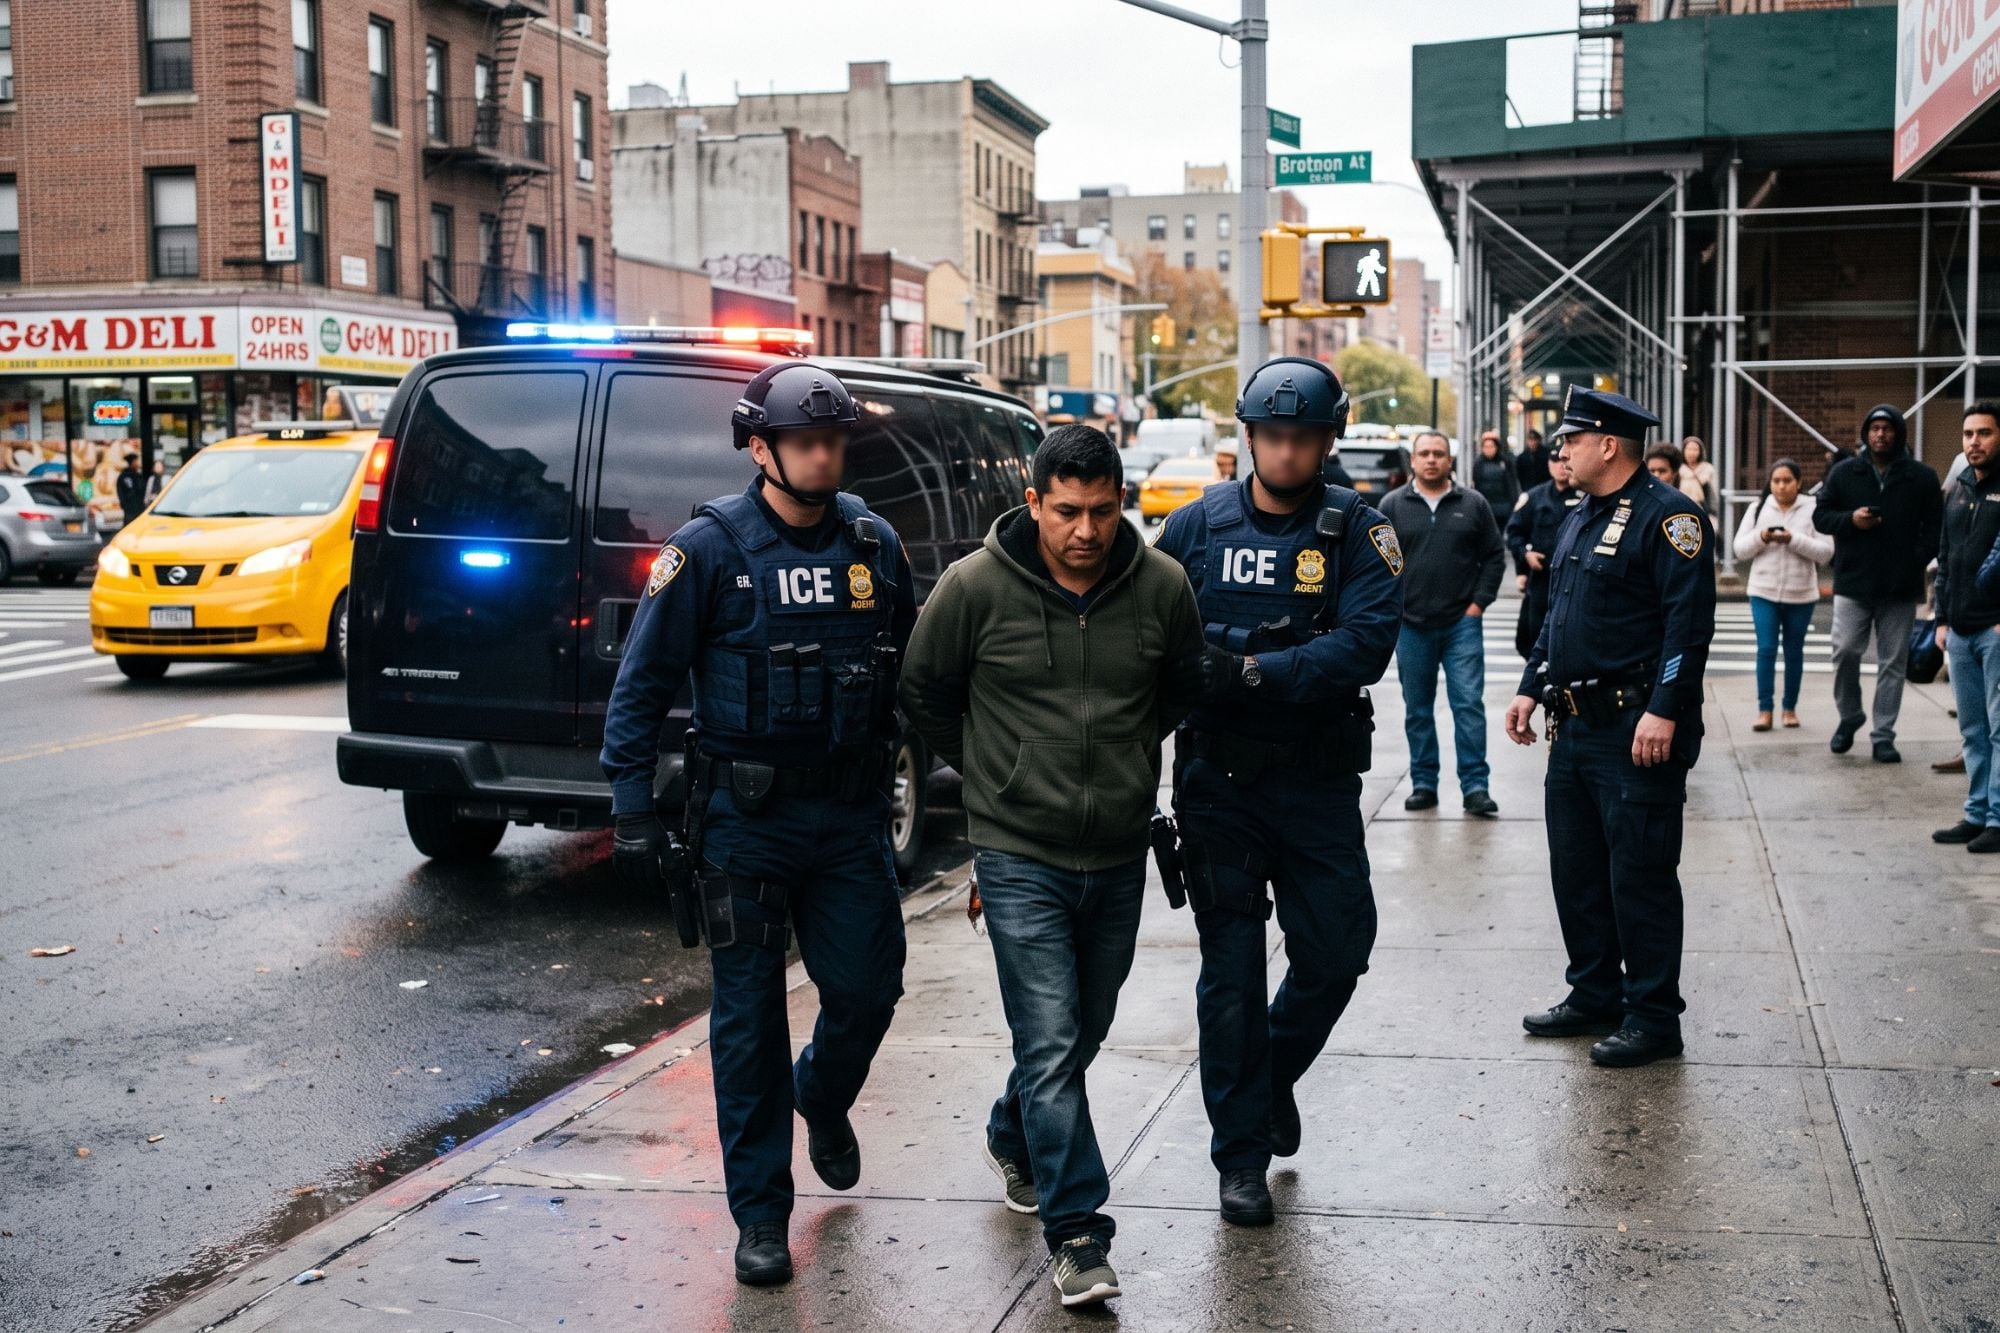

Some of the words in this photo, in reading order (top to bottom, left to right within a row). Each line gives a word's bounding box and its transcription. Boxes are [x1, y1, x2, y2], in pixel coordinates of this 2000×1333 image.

[1279, 156, 1343, 174] Brotnon
[0, 318, 89, 353] G&M
[104, 315, 216, 351] DELI
[251, 316, 303, 336] OPEN
[346, 321, 394, 356] G&M
[246, 341, 309, 361] 24HRS
[1221, 547, 1277, 586] ICE
[777, 567, 835, 605] ICE
[1293, 583, 1324, 594] AGENT
